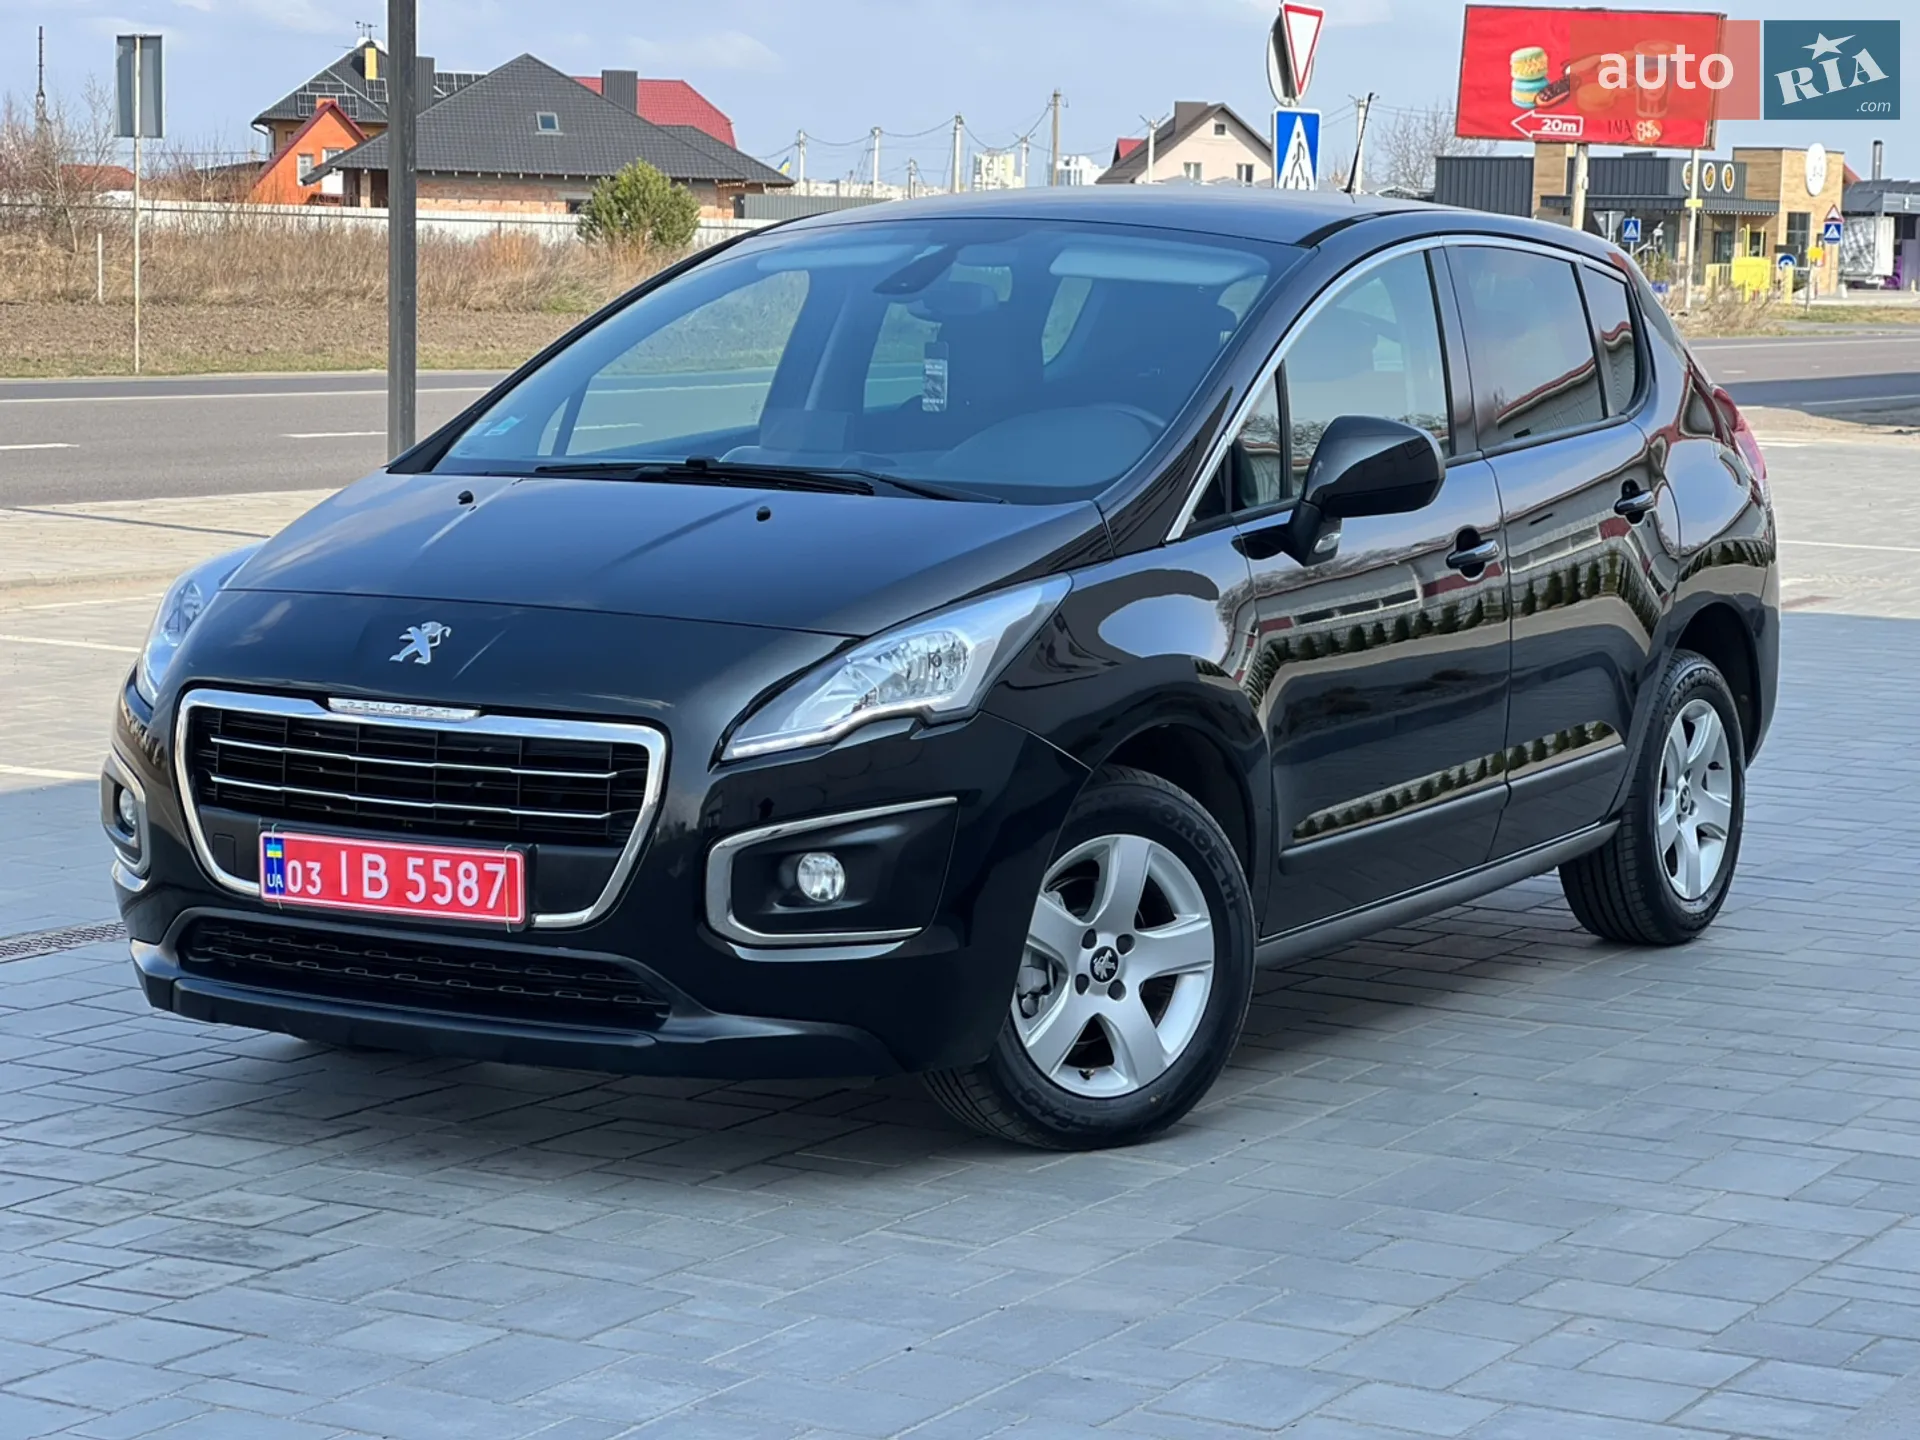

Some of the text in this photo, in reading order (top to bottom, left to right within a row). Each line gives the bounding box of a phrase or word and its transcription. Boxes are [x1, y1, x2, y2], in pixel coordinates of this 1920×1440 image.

[1541, 118, 1577, 133] 20m
[267, 873, 284, 888] UA
[286, 859, 322, 895] 03
[405, 856, 506, 909] 5587
